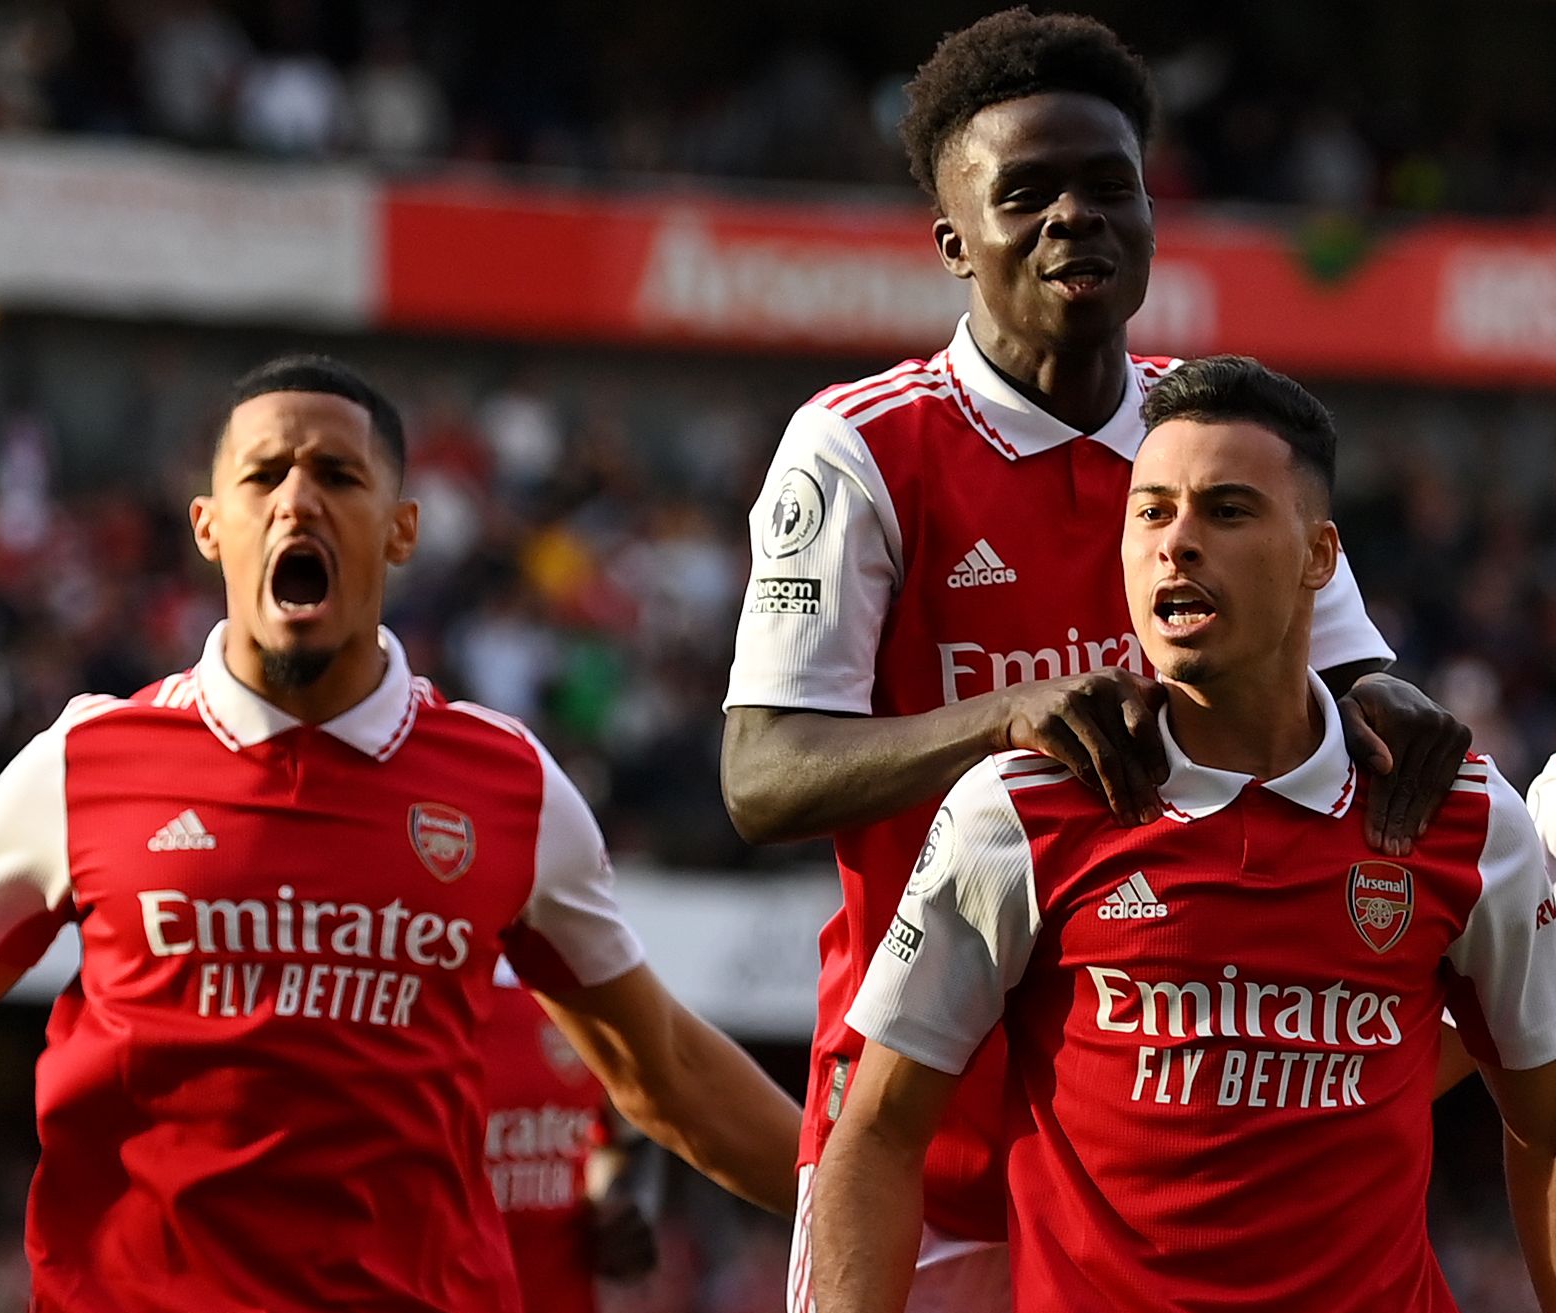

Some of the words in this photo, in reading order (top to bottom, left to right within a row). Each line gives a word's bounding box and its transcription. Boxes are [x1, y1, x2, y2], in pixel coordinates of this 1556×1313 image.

[947, 568, 1017, 588] adidas
[937, 627, 1157, 706] Emira
[1097, 900, 1168, 920] adidas
[1355, 874, 1405, 894] Arsenal
[137, 884, 473, 970] Emirates
[198, 963, 263, 1018] FLY
[275, 963, 421, 1028] BETTER
[1086, 964, 1402, 1047] Emirates
[1131, 1046, 1205, 1105] FLY
[1217, 1050, 1366, 1109] BETTER
